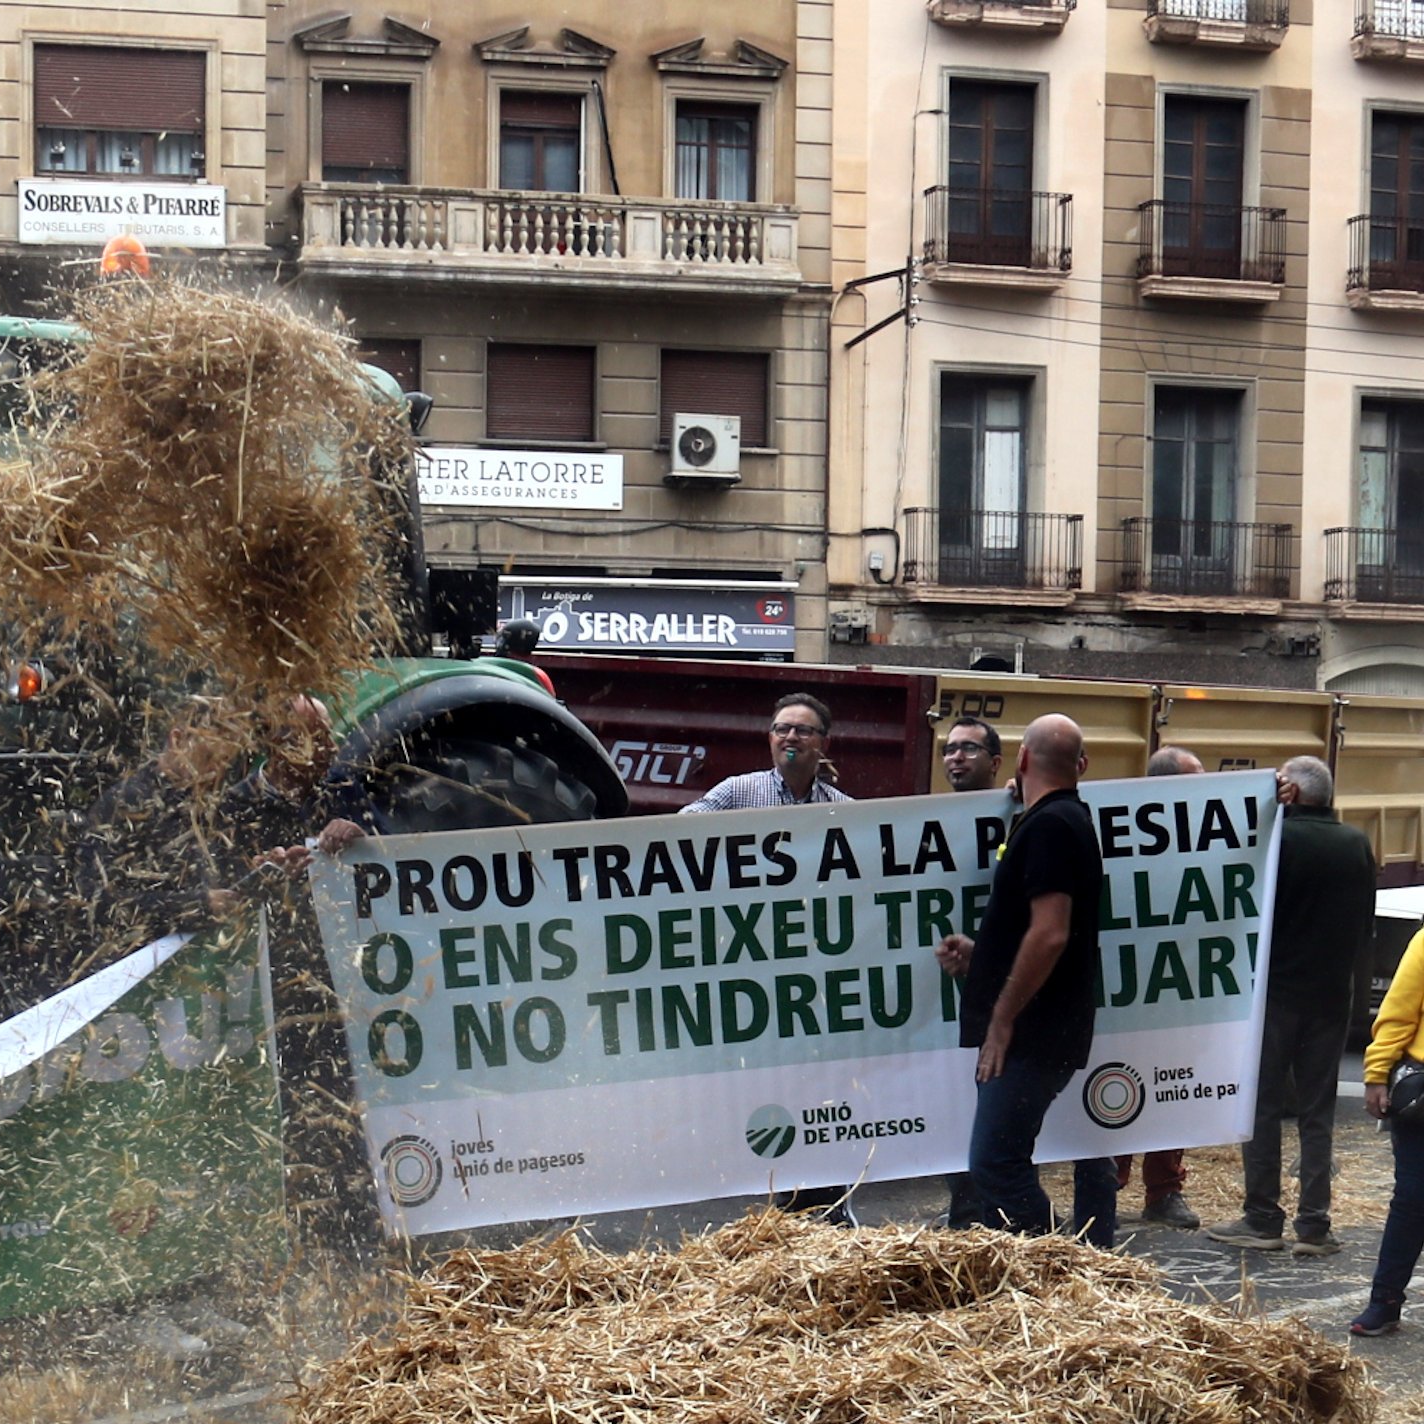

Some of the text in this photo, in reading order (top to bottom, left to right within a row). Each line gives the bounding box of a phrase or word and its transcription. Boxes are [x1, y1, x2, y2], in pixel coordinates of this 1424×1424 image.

[24, 189, 221, 217] SOBREVALS & PIFARRÉ
[24, 220, 105, 233] CONSELLERS
[416, 458, 604, 485] HER LATORRE
[434, 484, 578, 499] D'ASSEGURANCES
[577, 611, 738, 646] SERRALLER
[354, 796, 1258, 919] PROU TRAVES A LA PESIA!
[361, 862, 1260, 996] O ENS DEIXEU TRELLAR
[367, 1008, 423, 1078] O
[453, 996, 567, 1071] NO
[586, 964, 914, 1056] TINDREU
[1153, 1066, 1194, 1085] joves
[1155, 1084, 1189, 1103] unió
[1193, 1083, 1213, 1100] de
[802, 1101, 852, 1126] UNIÓ
[804, 1117, 926, 1146] DE PAGESOS
[451, 1139, 495, 1159] joves
[453, 1151, 586, 1179] unió de pagesos
